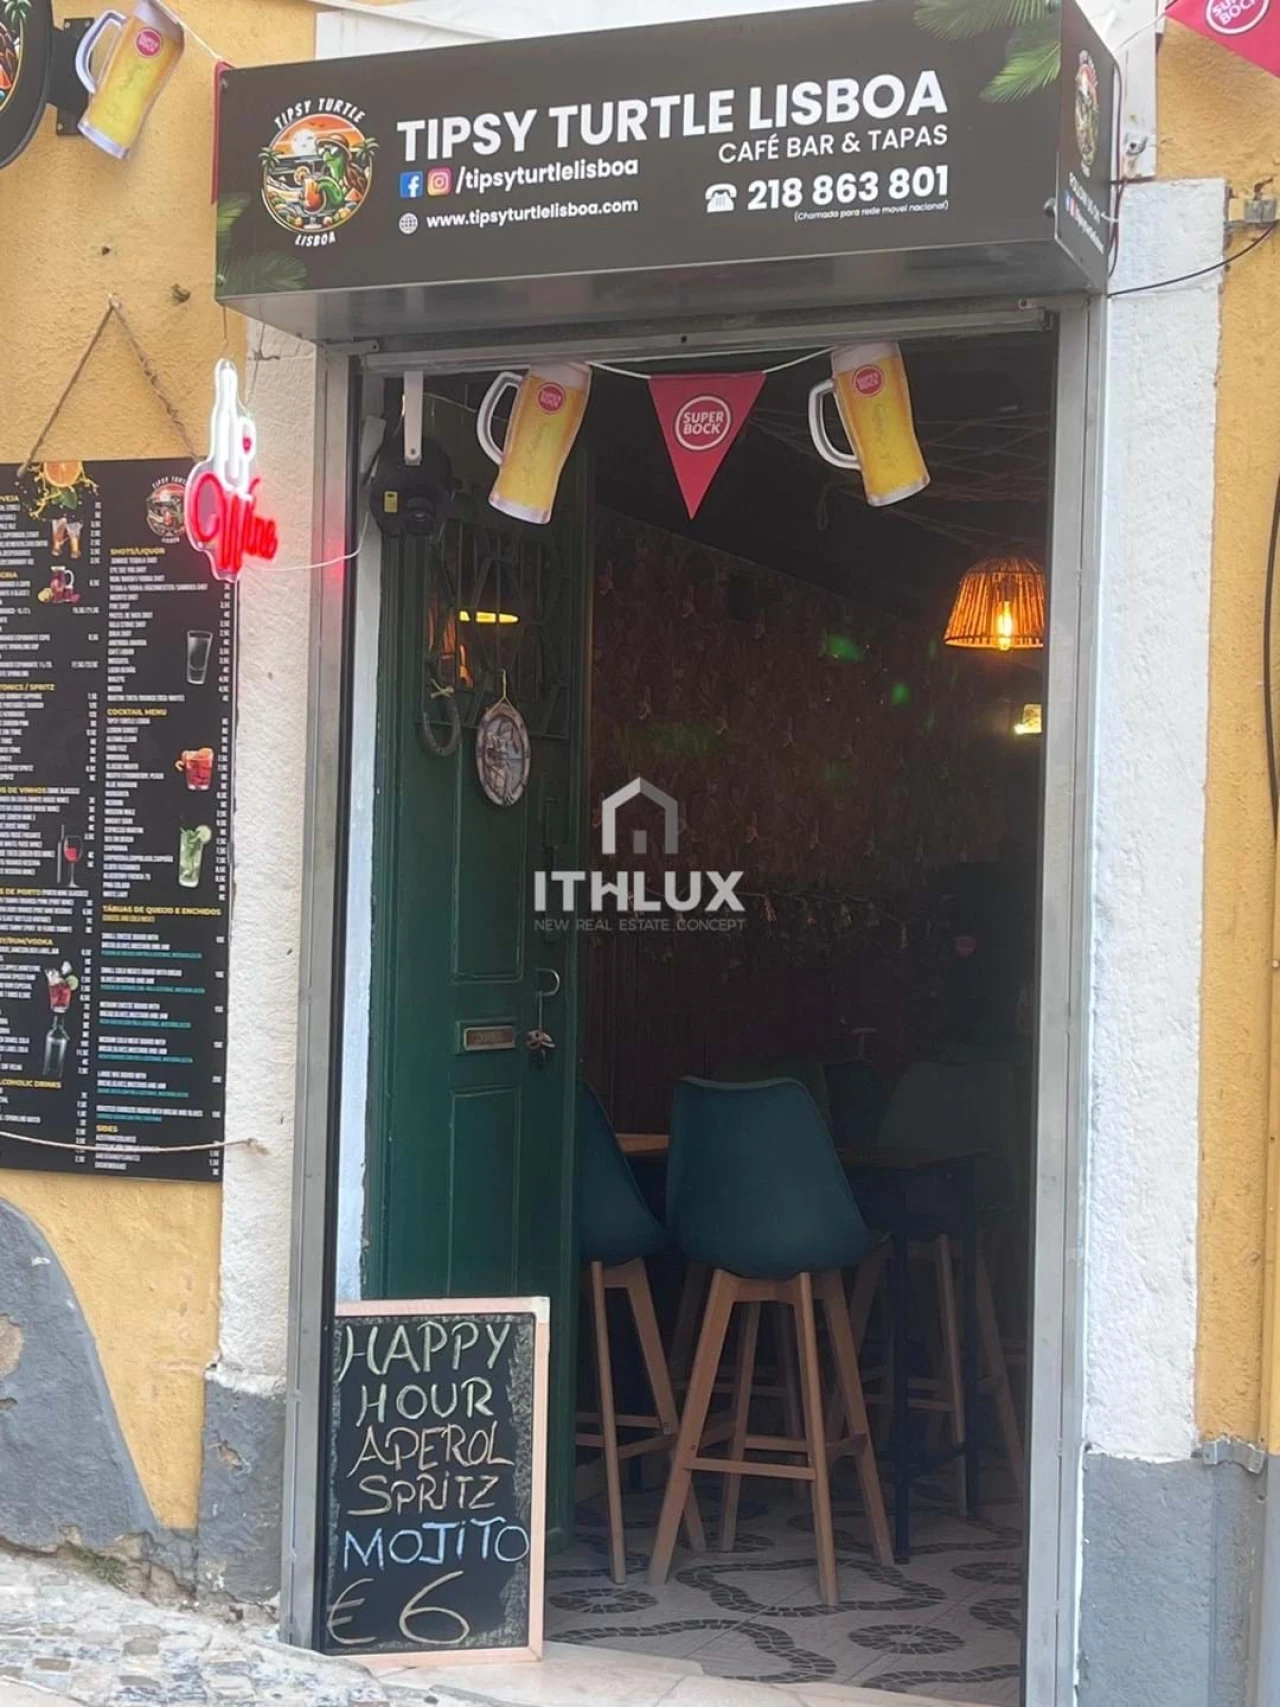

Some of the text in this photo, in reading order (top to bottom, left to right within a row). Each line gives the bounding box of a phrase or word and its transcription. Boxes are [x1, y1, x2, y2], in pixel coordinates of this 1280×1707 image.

[274, 98, 366, 129] TIPSY TURTLE
[397, 70, 948, 163] TIPSY TURTLE LISBOA
[718, 124, 948, 164] CAFÉ BAR & TAPAS
[455, 157, 639, 194] /tipsyturtlelisboa
[748, 165, 948, 211] 218 863 801
[426, 198, 639, 231] www.tipsyturtlelisboa.com
[294, 231, 336, 247] LISBOA
[682, 410, 724, 424] SUPER
[683, 422, 721, 435] BOCK
[337, 1320, 510, 1383] HAPPY
[356, 1376, 494, 1427] HOUR
[346, 1420, 514, 1478] APEROL
[326, 1570, 470, 1645] € 6
